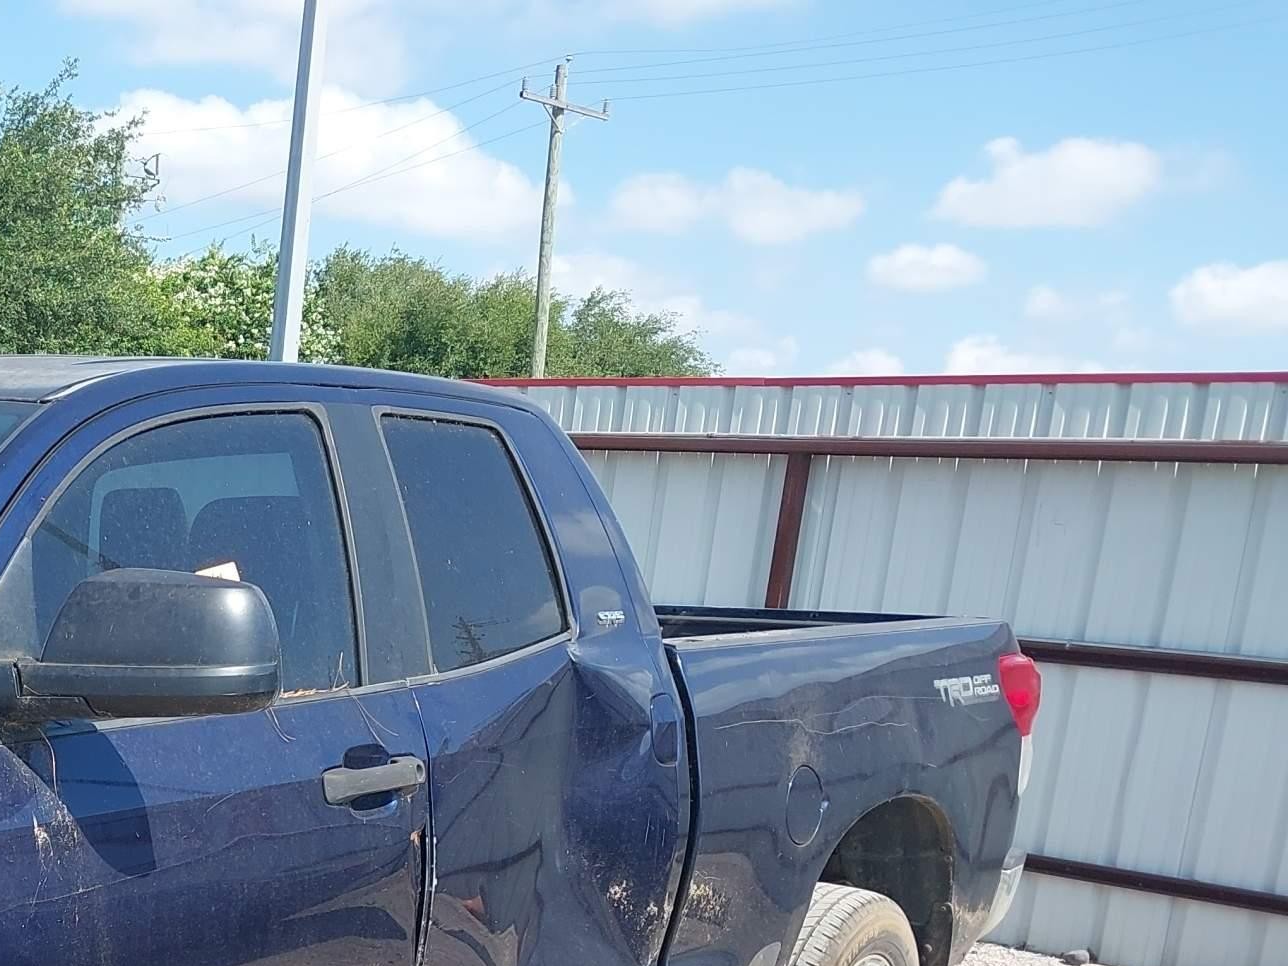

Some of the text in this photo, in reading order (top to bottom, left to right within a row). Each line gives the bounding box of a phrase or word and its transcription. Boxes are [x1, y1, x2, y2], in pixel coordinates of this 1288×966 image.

[973, 674, 992, 684] OFF
[933, 676, 973, 707] TRD
[974, 684, 1000, 696] ROAD
